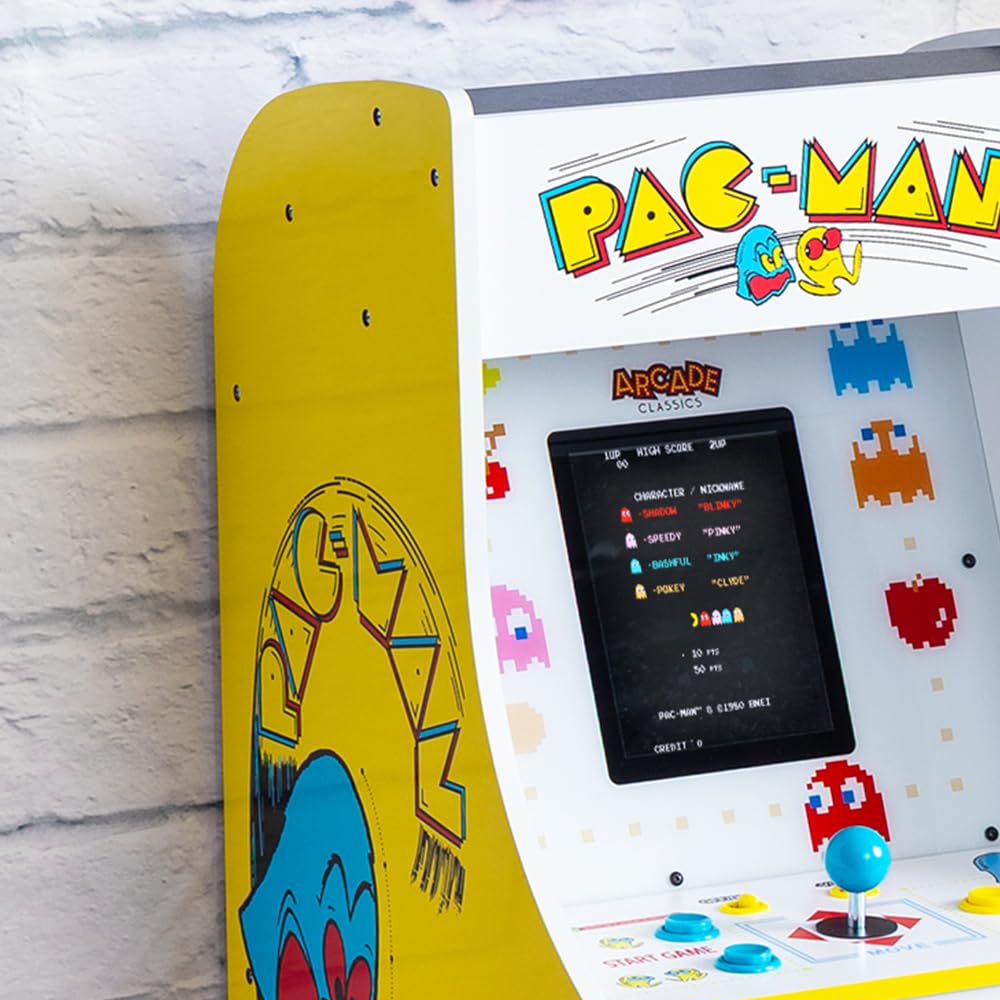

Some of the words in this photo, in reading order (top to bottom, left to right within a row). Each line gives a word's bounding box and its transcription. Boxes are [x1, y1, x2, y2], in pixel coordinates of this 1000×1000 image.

[612, 360, 722, 401] ARCADE
[638, 397, 703, 414] CLASSICS
[604, 449, 621, 461] 1UP
[636, 444, 661, 457] HIGH
[664, 442, 694, 455] SCORE
[708, 438, 727, 450] 2UP
[633, 487, 685, 502] CHARACTER
[700, 481, 744, 495] NICKNAME
[653, 741, 687, 754] CREDIT
[602, 954, 658, 969] START
[660, 945, 719, 961] GAME
